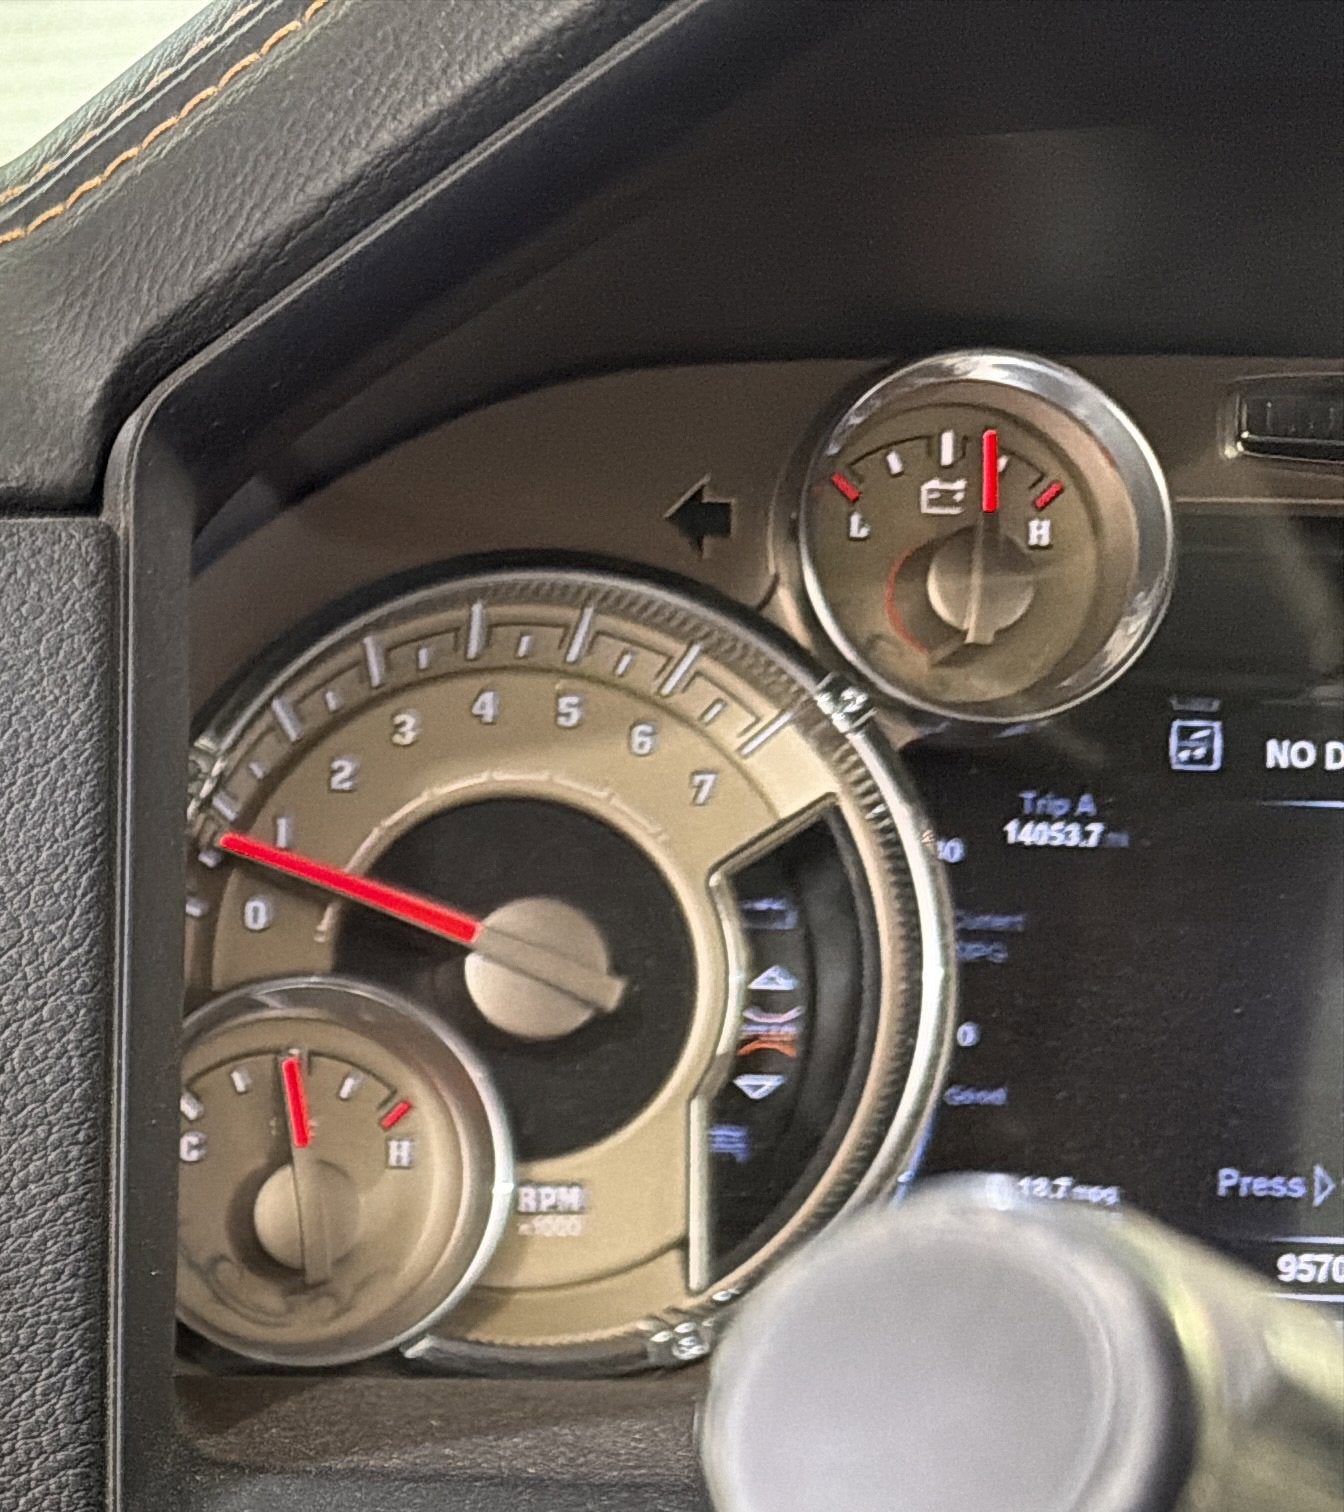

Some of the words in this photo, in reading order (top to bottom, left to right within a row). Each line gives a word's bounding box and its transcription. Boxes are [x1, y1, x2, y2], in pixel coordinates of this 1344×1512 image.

[1027, 518, 1051, 548] H
[472, 691, 499, 723] 4
[557, 694, 582, 728] 5
[392, 711, 418, 745] 3
[630, 723, 656, 755] 6
[1266, 739, 1316, 769] NO
[329, 758, 356, 791] 2
[691, 772, 718, 805] 7
[1019, 790, 1072, 817] Trip
[1073, 793, 1098, 816] A
[276, 816, 292, 849] 1
[244, 896, 272, 930] 0
[179, 1131, 206, 1162] C
[387, 1138, 414, 1168] H
[1217, 1167, 1307, 1197] Press
[517, 1185, 583, 1212] RPM
